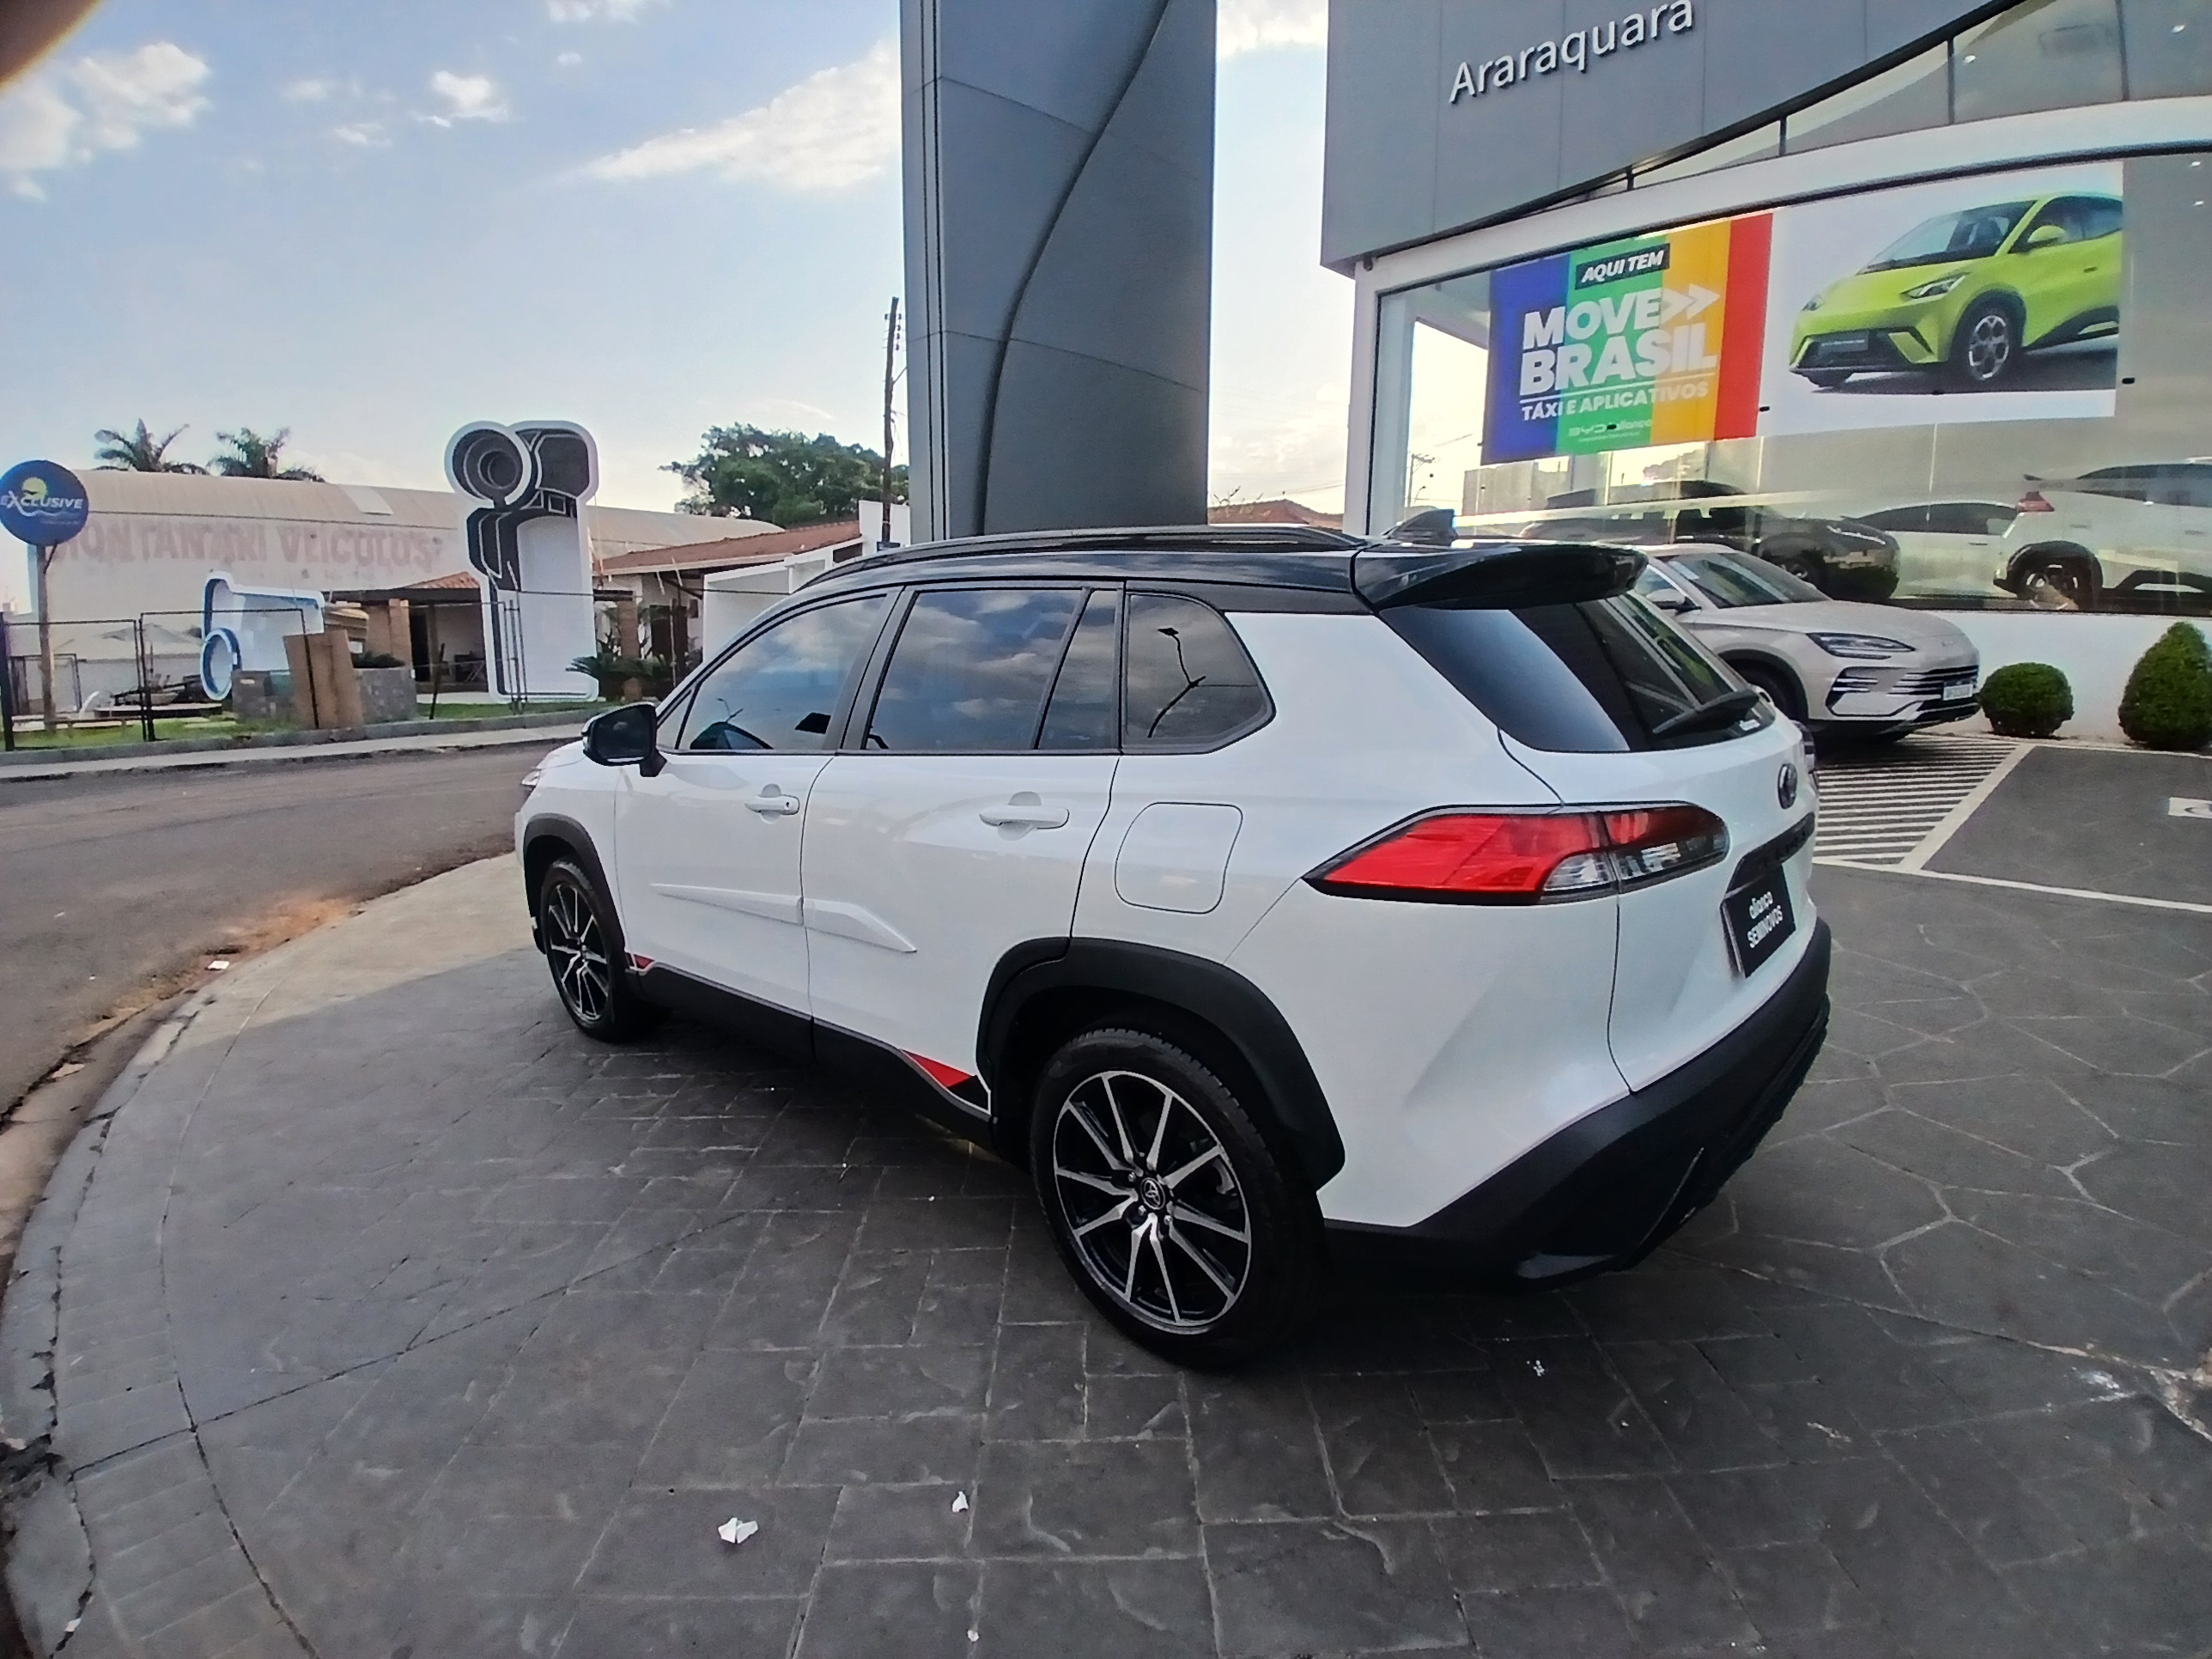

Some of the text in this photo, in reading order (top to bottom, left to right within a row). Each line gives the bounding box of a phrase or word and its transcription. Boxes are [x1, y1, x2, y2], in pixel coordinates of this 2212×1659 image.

[1449, 0, 1693, 104] Araraquara
[1582, 249, 1665, 283] AQUI TEM
[1523, 287, 1662, 349] MOVE
[1519, 321, 1720, 397] BRASIL
[1565, 400, 1577, 416] E
[1578, 380, 1710, 414] APLICATIVOS
